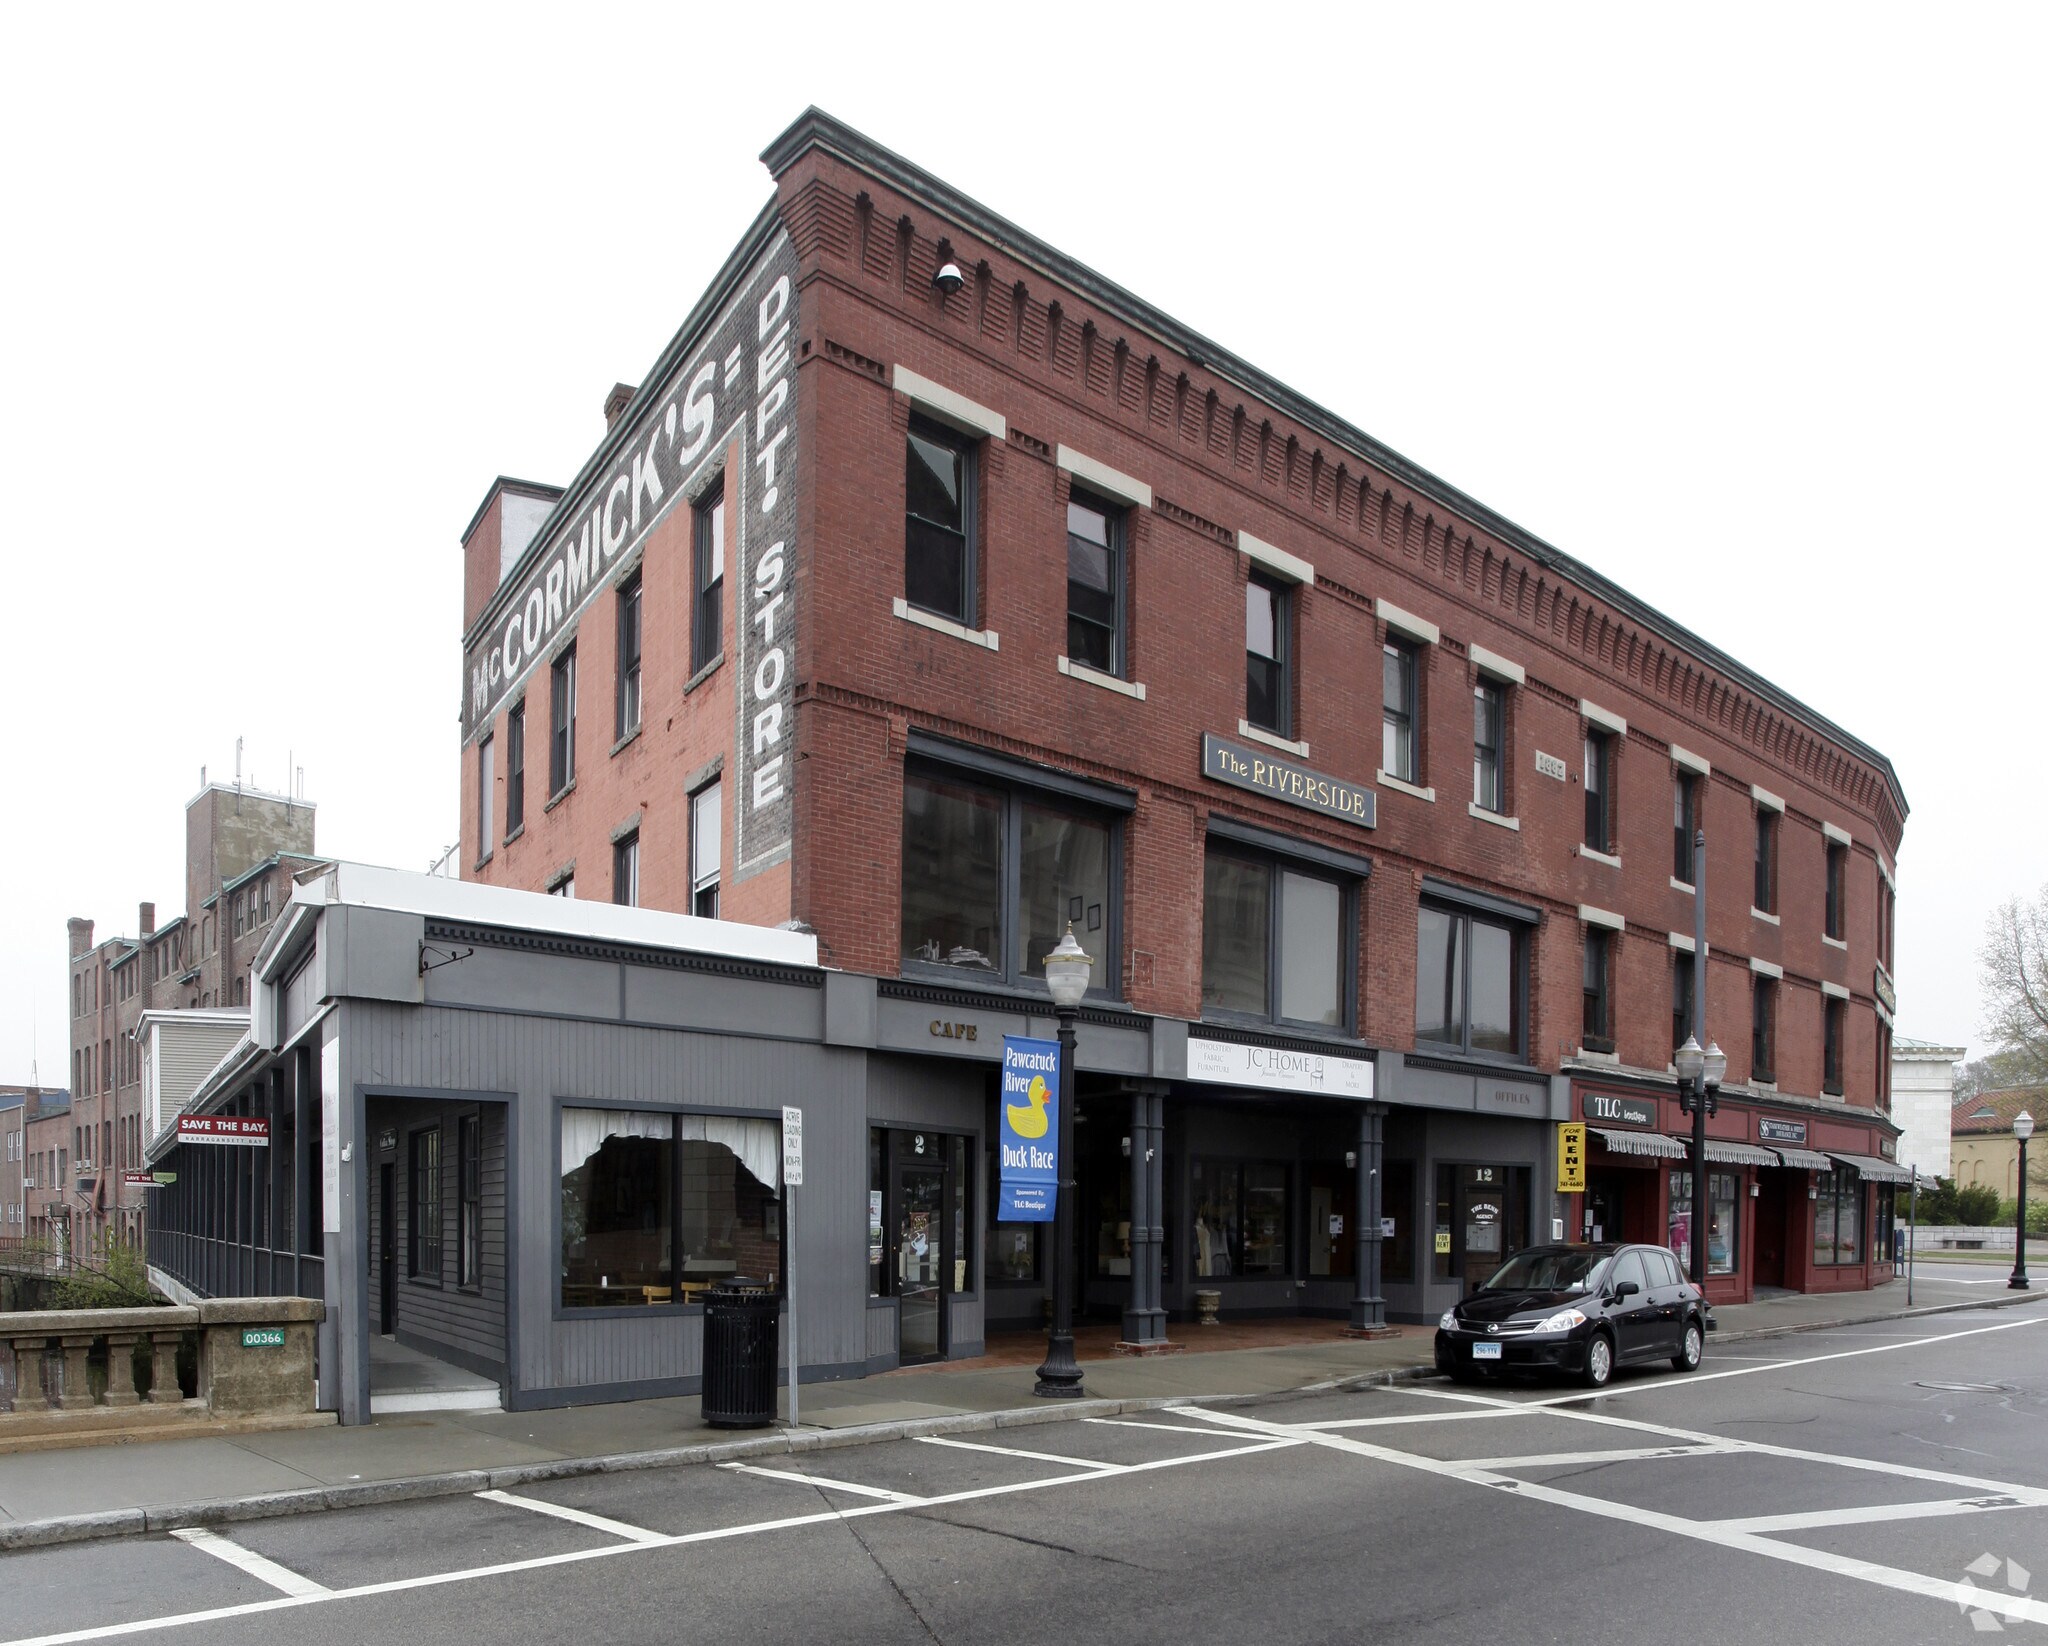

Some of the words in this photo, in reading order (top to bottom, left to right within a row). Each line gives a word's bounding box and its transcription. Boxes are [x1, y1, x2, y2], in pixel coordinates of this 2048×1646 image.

[756, 275, 789, 514] DEPT.
[753, 541, 785, 810] STORE
[1217, 749, 1248, 777] The
[1252, 759, 1365, 818] RIVERSIDE
[929, 1019, 978, 1042] CAFE
[1195, 1040, 1232, 1053] UPHOLSTERY
[1006, 1047, 1056, 1072] Pawcatuck
[1203, 1053, 1224, 1063] FABRIC
[1246, 1047, 1263, 1070] JC
[1268, 1050, 1310, 1073] HOME
[1197, 1063, 1230, 1074] FURNITURE
[1004, 1071, 1031, 1093] River
[1495, 1090, 1530, 1104] OFFICES
[1594, 1096, 1621, 1118] TLC
[181, 1119, 211, 1130] SAVE
[216, 1121, 238, 1131] THE
[784, 1124, 801, 1137] LOADING
[185, 1136, 245, 1144] NARRAGANSETT
[787, 1137, 798, 1149] ONLY
[914, 1134, 925, 1155] 2
[1003, 1145, 1028, 1169] Duck
[1030, 1147, 1054, 1169] Race
[1565, 1135, 1579, 1176] RENT
[1475, 1168, 1493, 1182] 12
[1014, 1200, 1025, 1209] TLC
[1025, 1200, 1046, 1210] Boutique
[1471, 1204, 1482, 1213] THE
[1438, 1234, 1448, 1242] FOR
[246, 1333, 281, 1344] 00366
